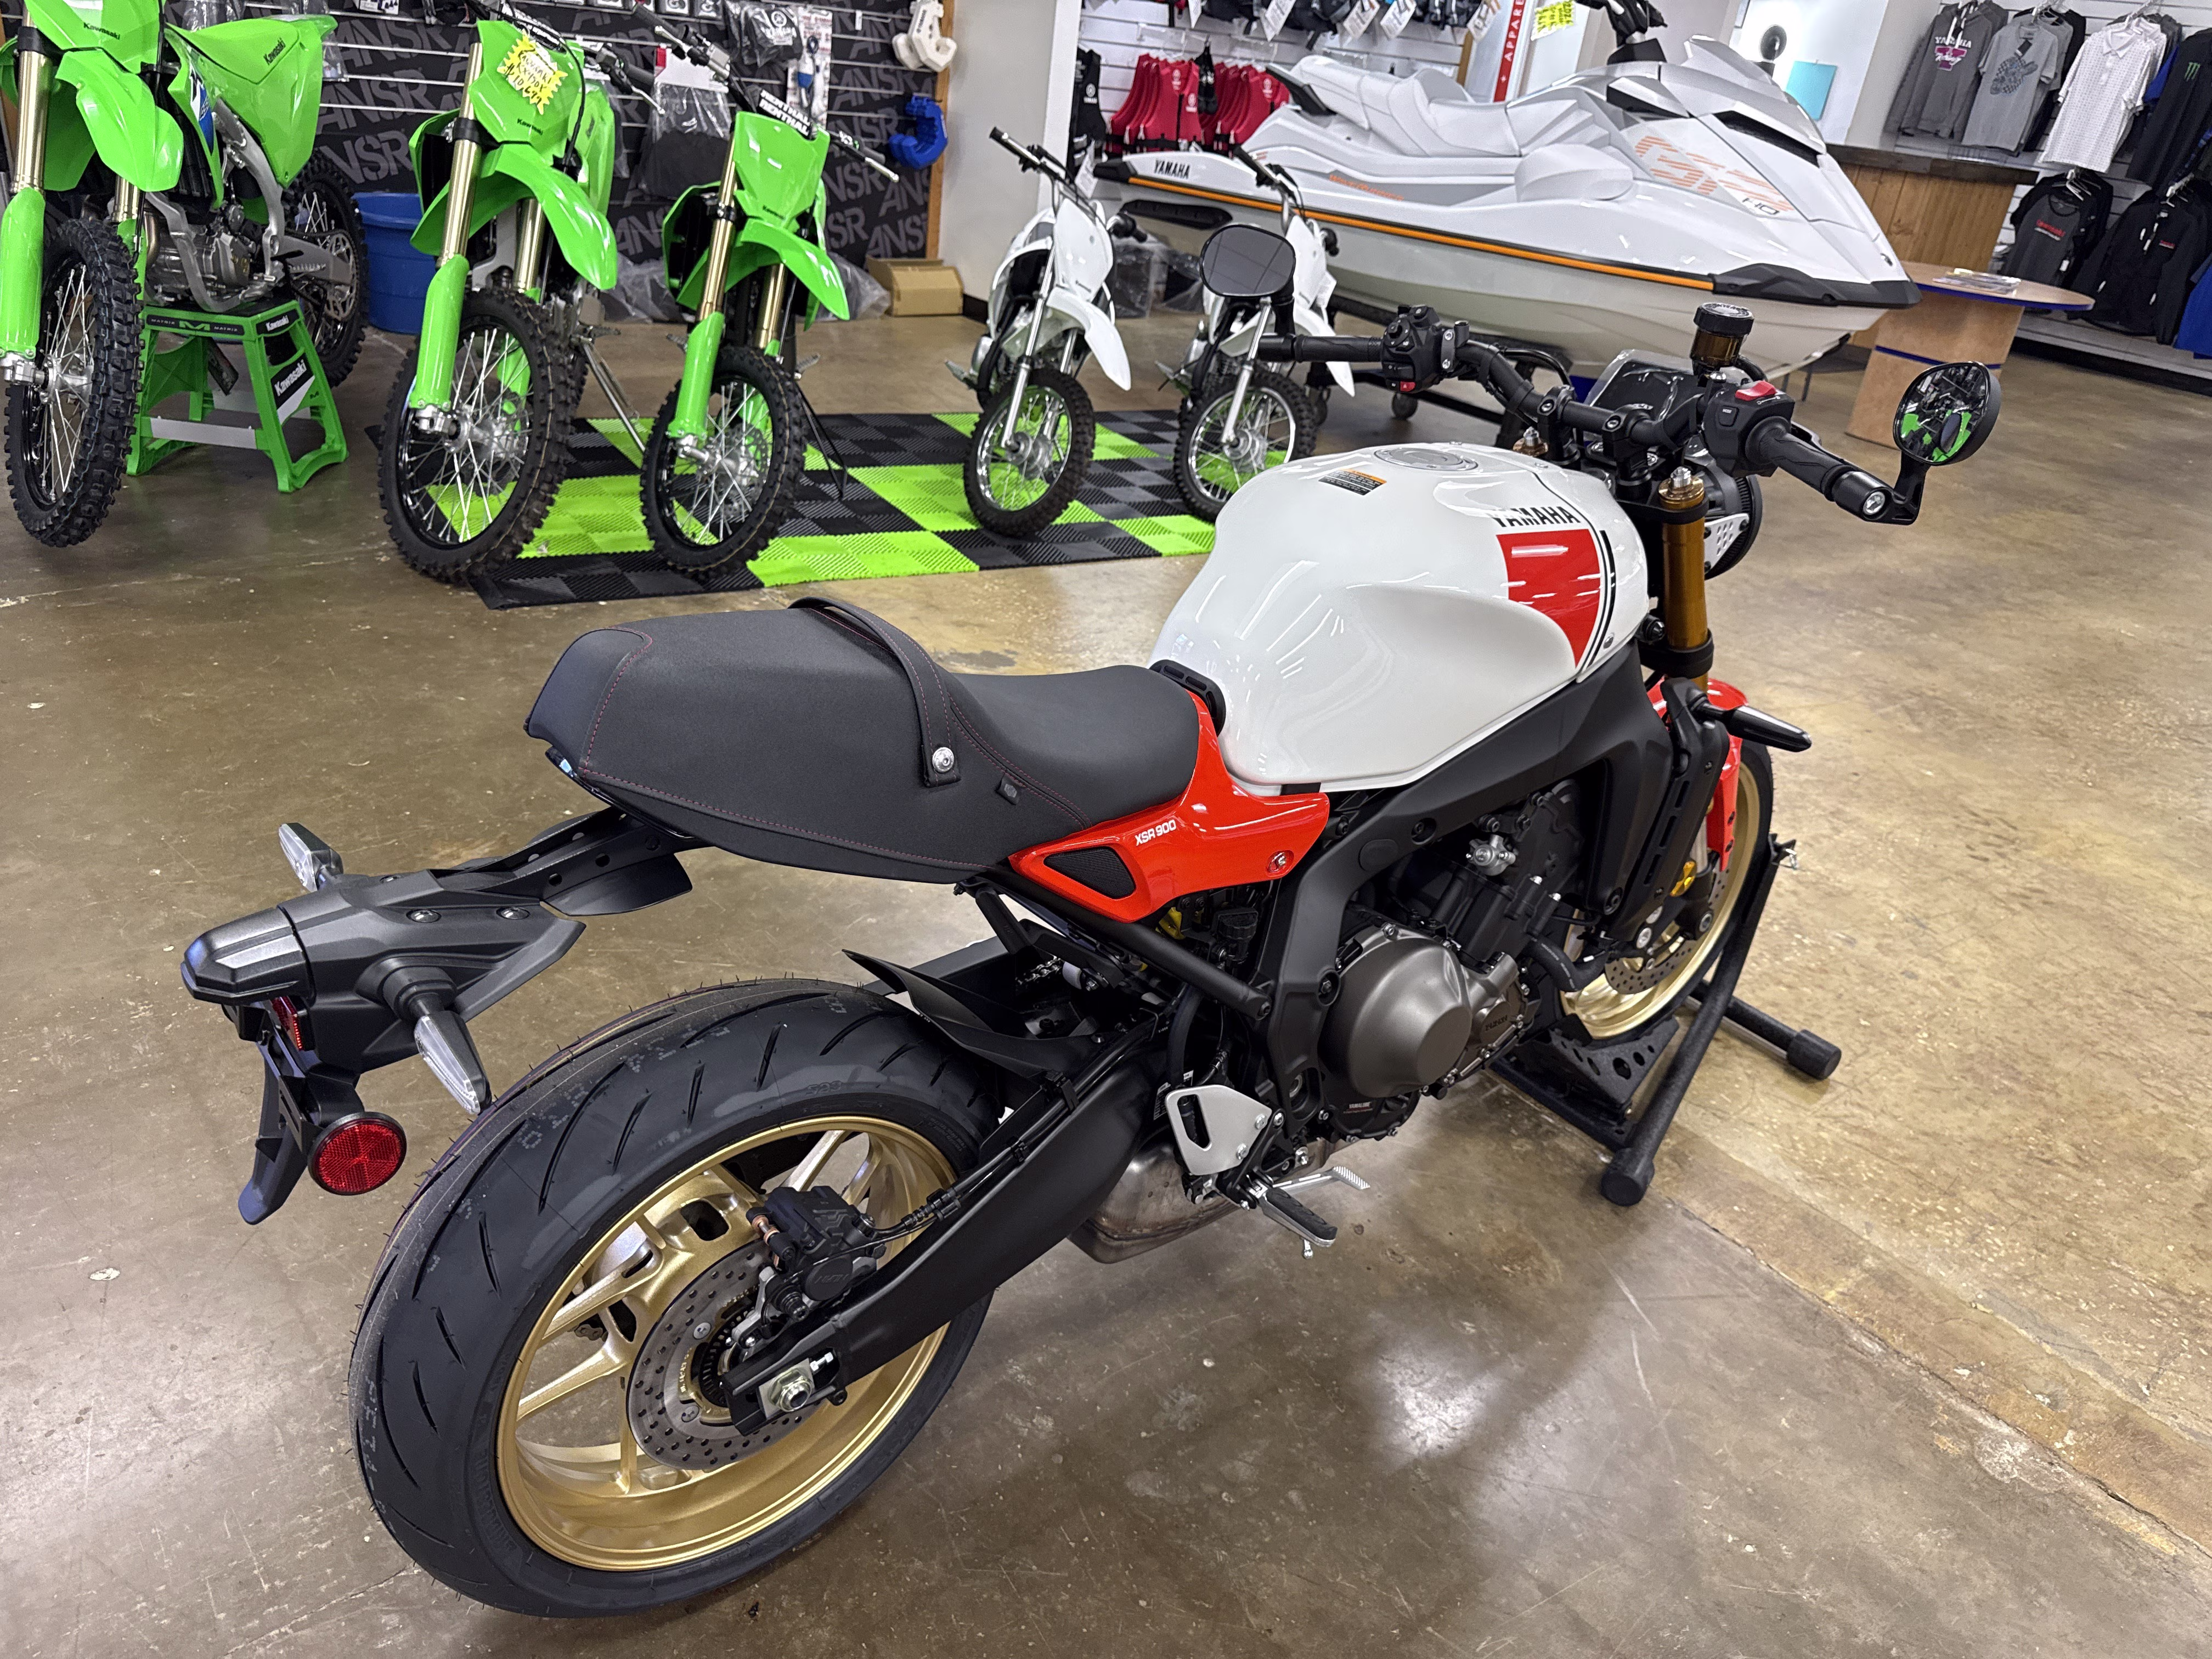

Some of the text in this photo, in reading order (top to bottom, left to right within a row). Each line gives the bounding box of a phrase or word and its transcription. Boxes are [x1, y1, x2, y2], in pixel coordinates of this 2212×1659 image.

[83, 22, 120, 40] Kawasaki
[263, 37, 286, 65] Kawasaki
[759, 99, 809, 136] RENTHAL
[760, 89, 810, 127] RENTHAL
[319, 130, 415, 184] NSR
[1154, 159, 1190, 179] YAMAHA
[265, 315, 290, 332] Kawasaki
[274, 359, 307, 397] Kawasaki
[1486, 506, 1581, 527] YAMAHA
[1135, 819, 1177, 847] XSR 900
